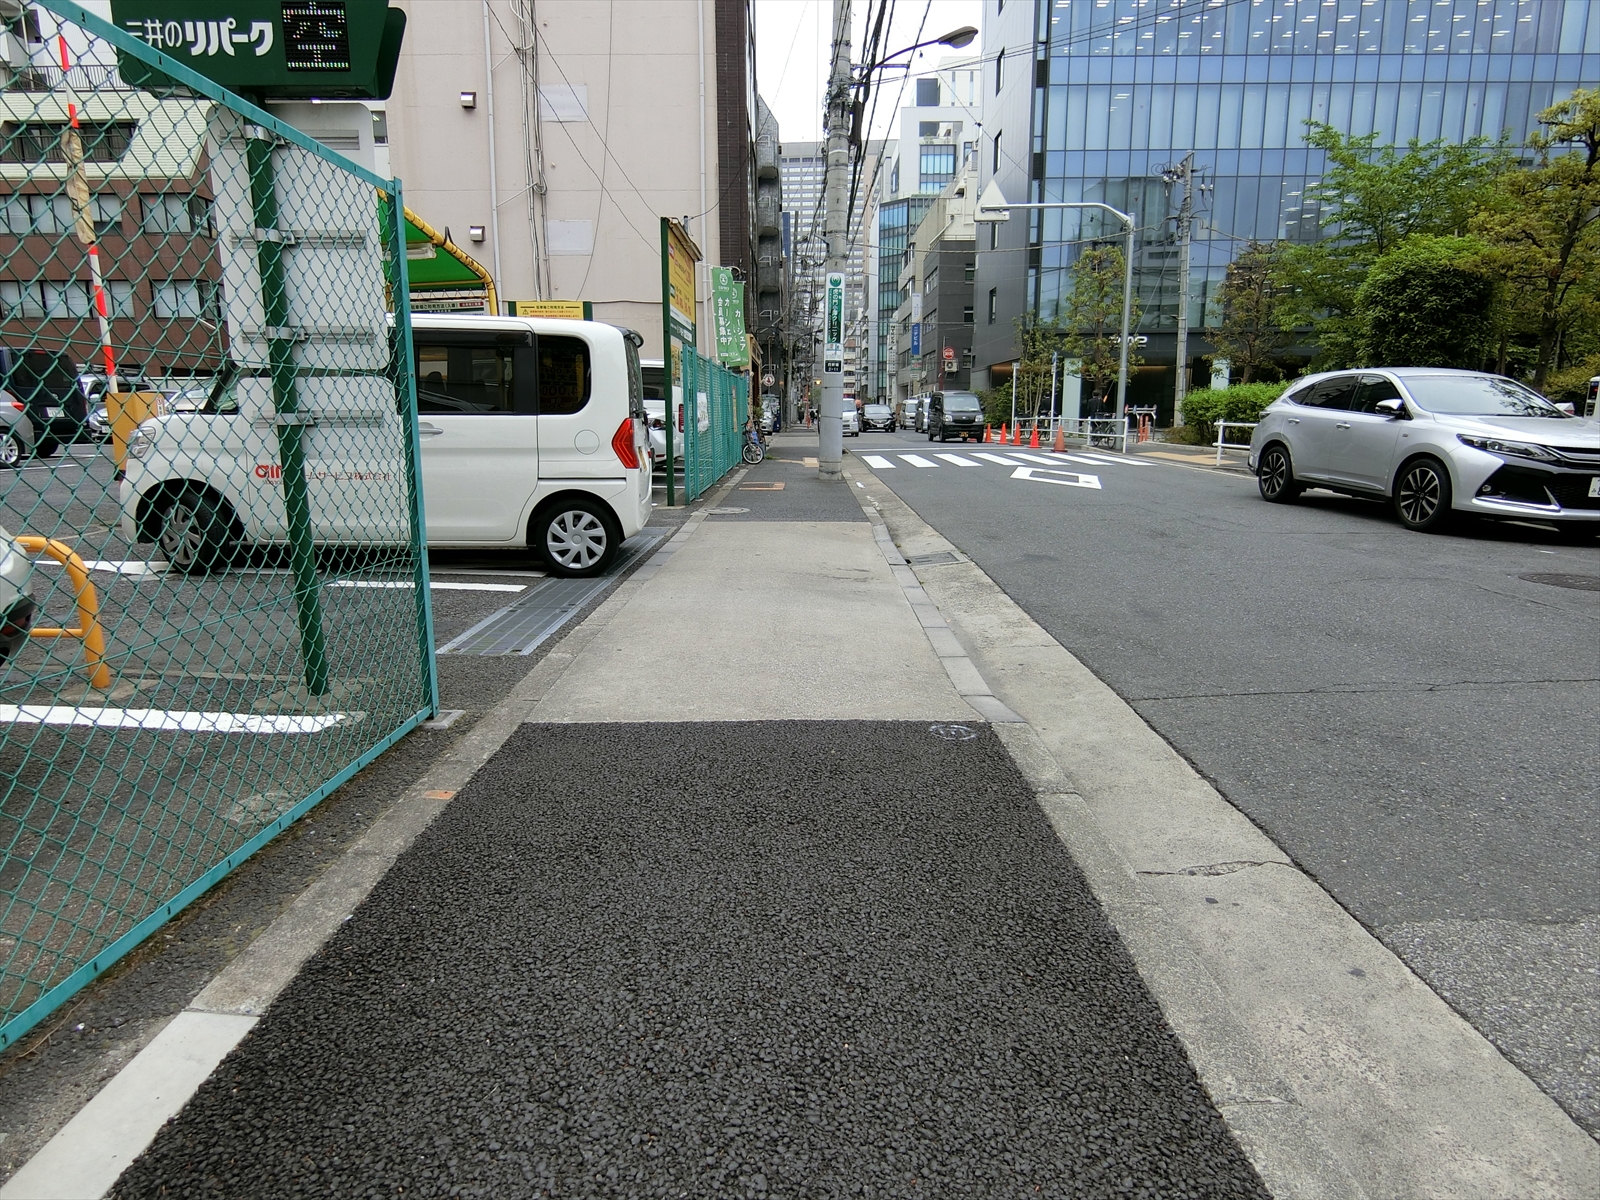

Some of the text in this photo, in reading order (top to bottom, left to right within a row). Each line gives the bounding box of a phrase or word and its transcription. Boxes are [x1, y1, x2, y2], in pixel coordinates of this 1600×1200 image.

[125, 17, 274, 57] 三井のリパーク
[717, 297, 728, 346] 会員募集中
[724, 297, 733, 346] カーシェア
[735, 309, 747, 352] カーシェア
